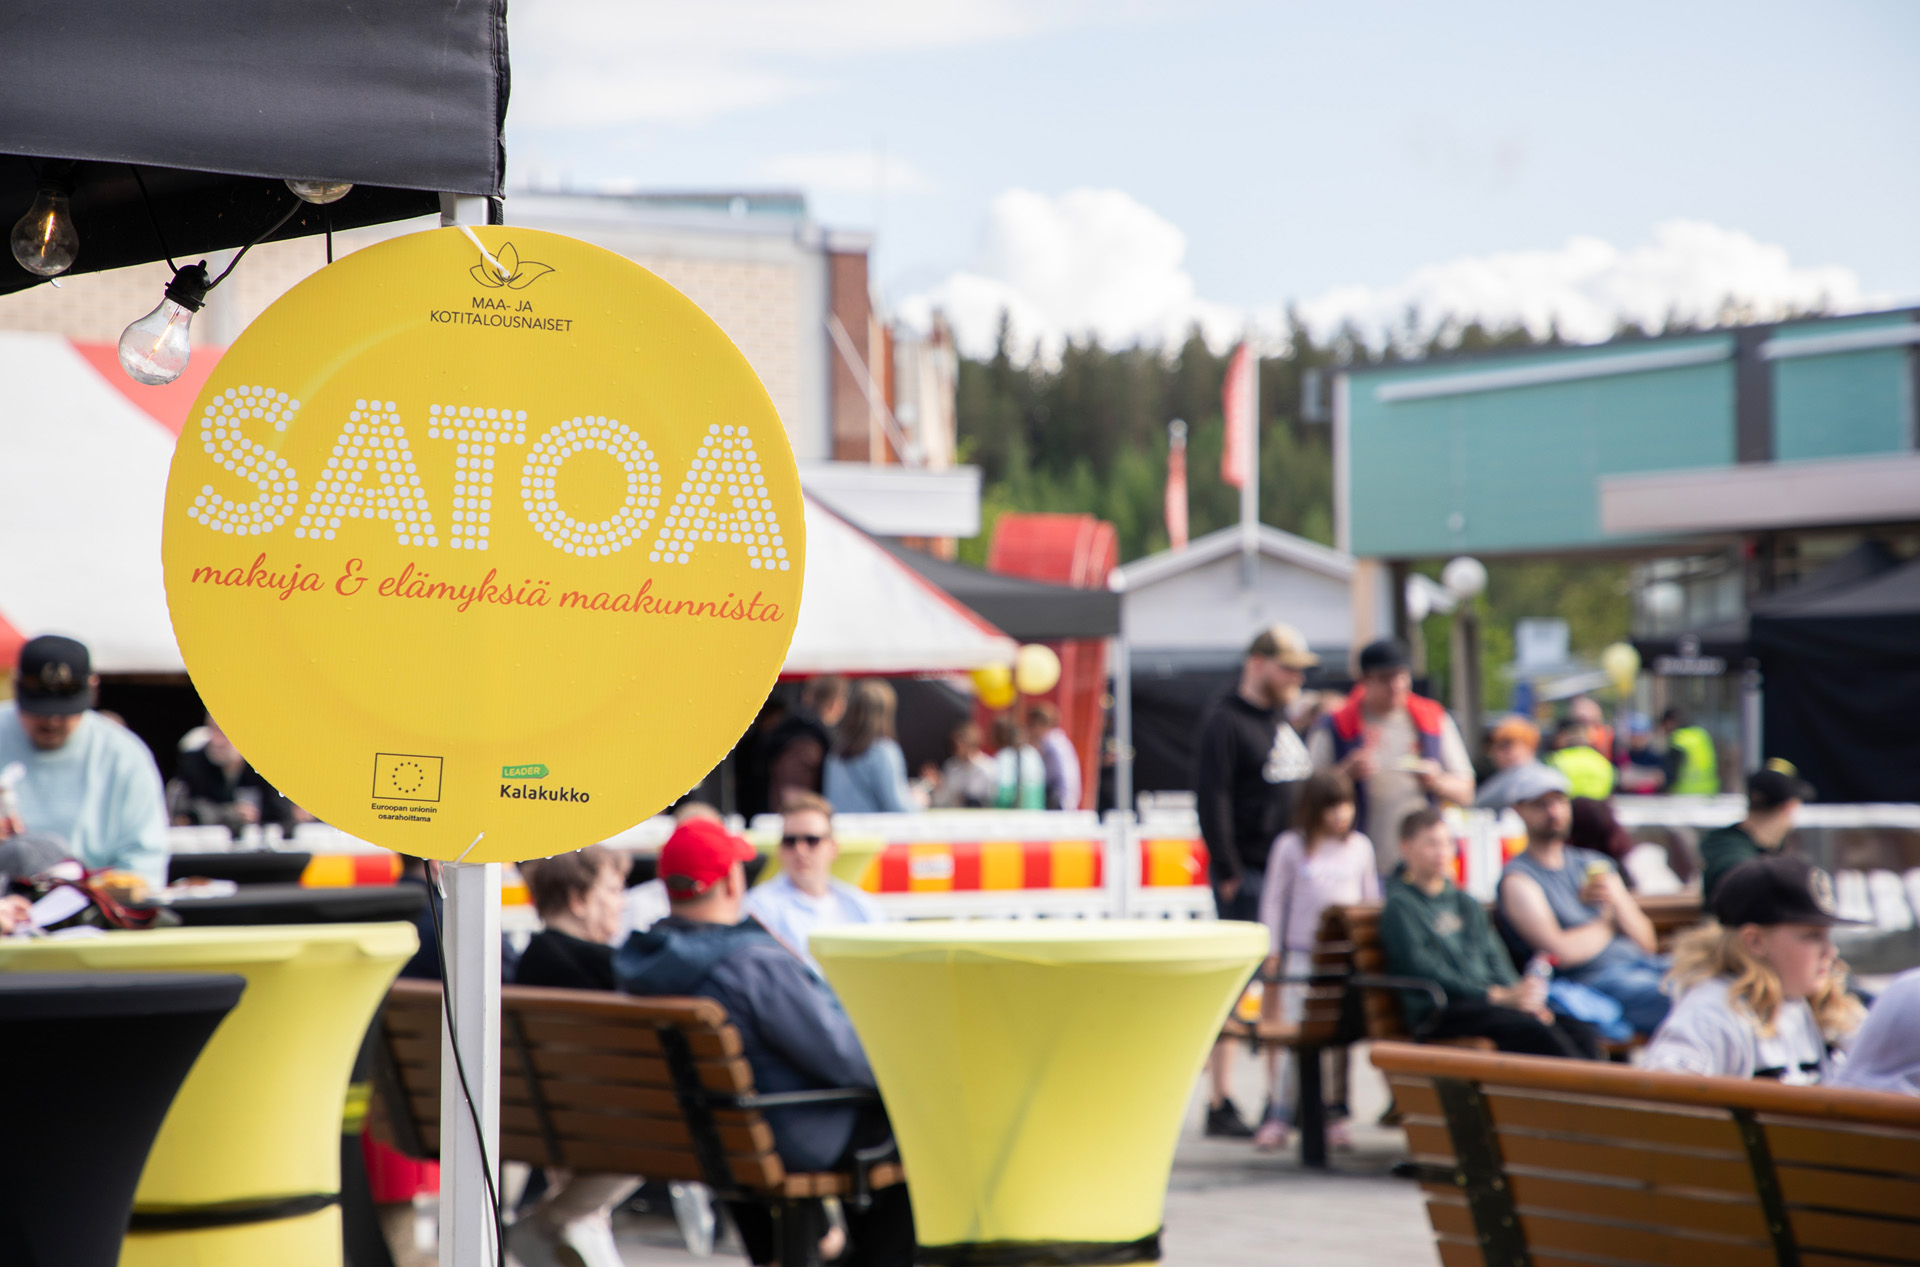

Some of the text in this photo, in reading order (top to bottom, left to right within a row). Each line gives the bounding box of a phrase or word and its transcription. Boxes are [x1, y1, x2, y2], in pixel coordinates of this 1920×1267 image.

[471, 297, 533, 313] MAA- JA
[430, 310, 573, 332] KOTITALOUSNAISET
[187, 385, 790, 571] SATOA
[191, 552, 785, 622] makuja & elämyksiä maakunnista
[504, 766, 541, 777] LEADER
[500, 784, 590, 804] Kalakukko
[371, 803, 438, 814] Euroopan unionin
[377, 813, 431, 823] osarahoittama
